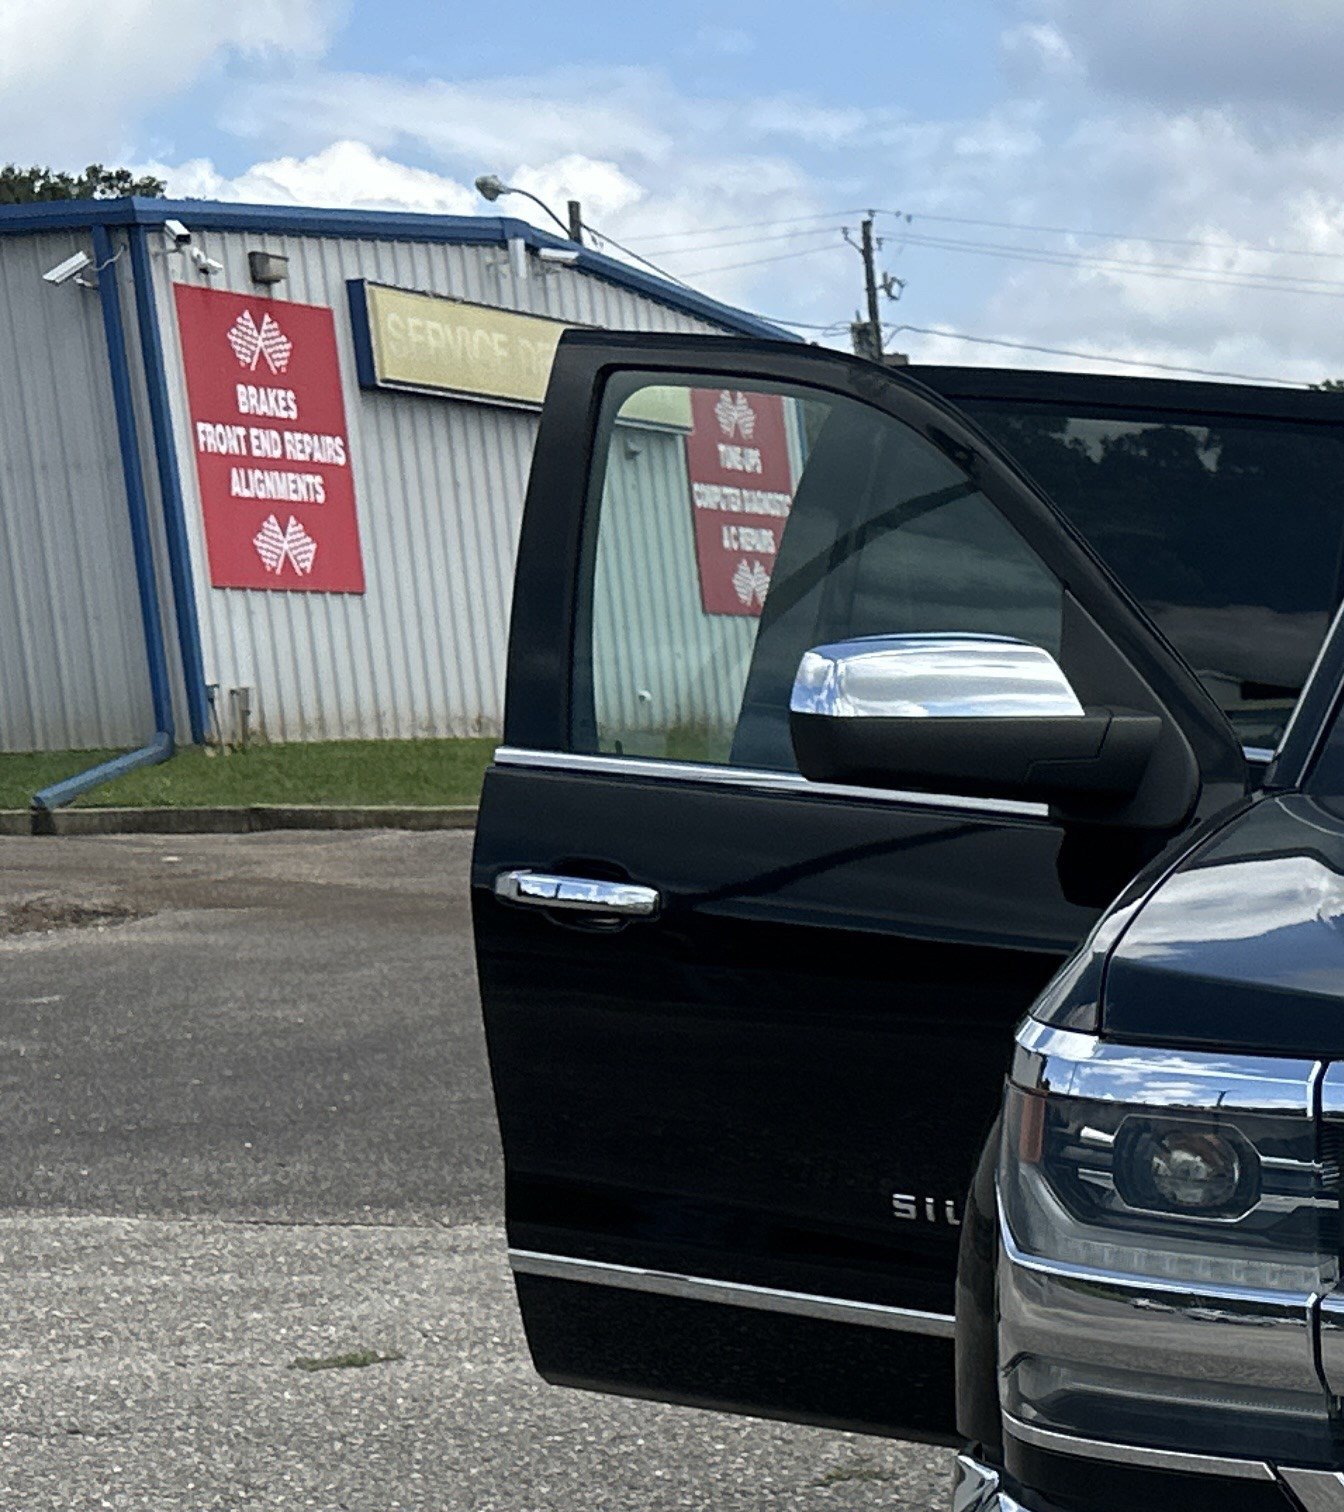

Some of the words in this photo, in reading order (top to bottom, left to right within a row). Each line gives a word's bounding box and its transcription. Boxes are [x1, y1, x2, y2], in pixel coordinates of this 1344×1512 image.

[236, 383, 298, 421] BRAKES
[196, 421, 247, 456] FRONT
[249, 427, 282, 459] END
[283, 431, 347, 467] REPAIRS
[231, 467, 325, 505] ALIGNMENTS
